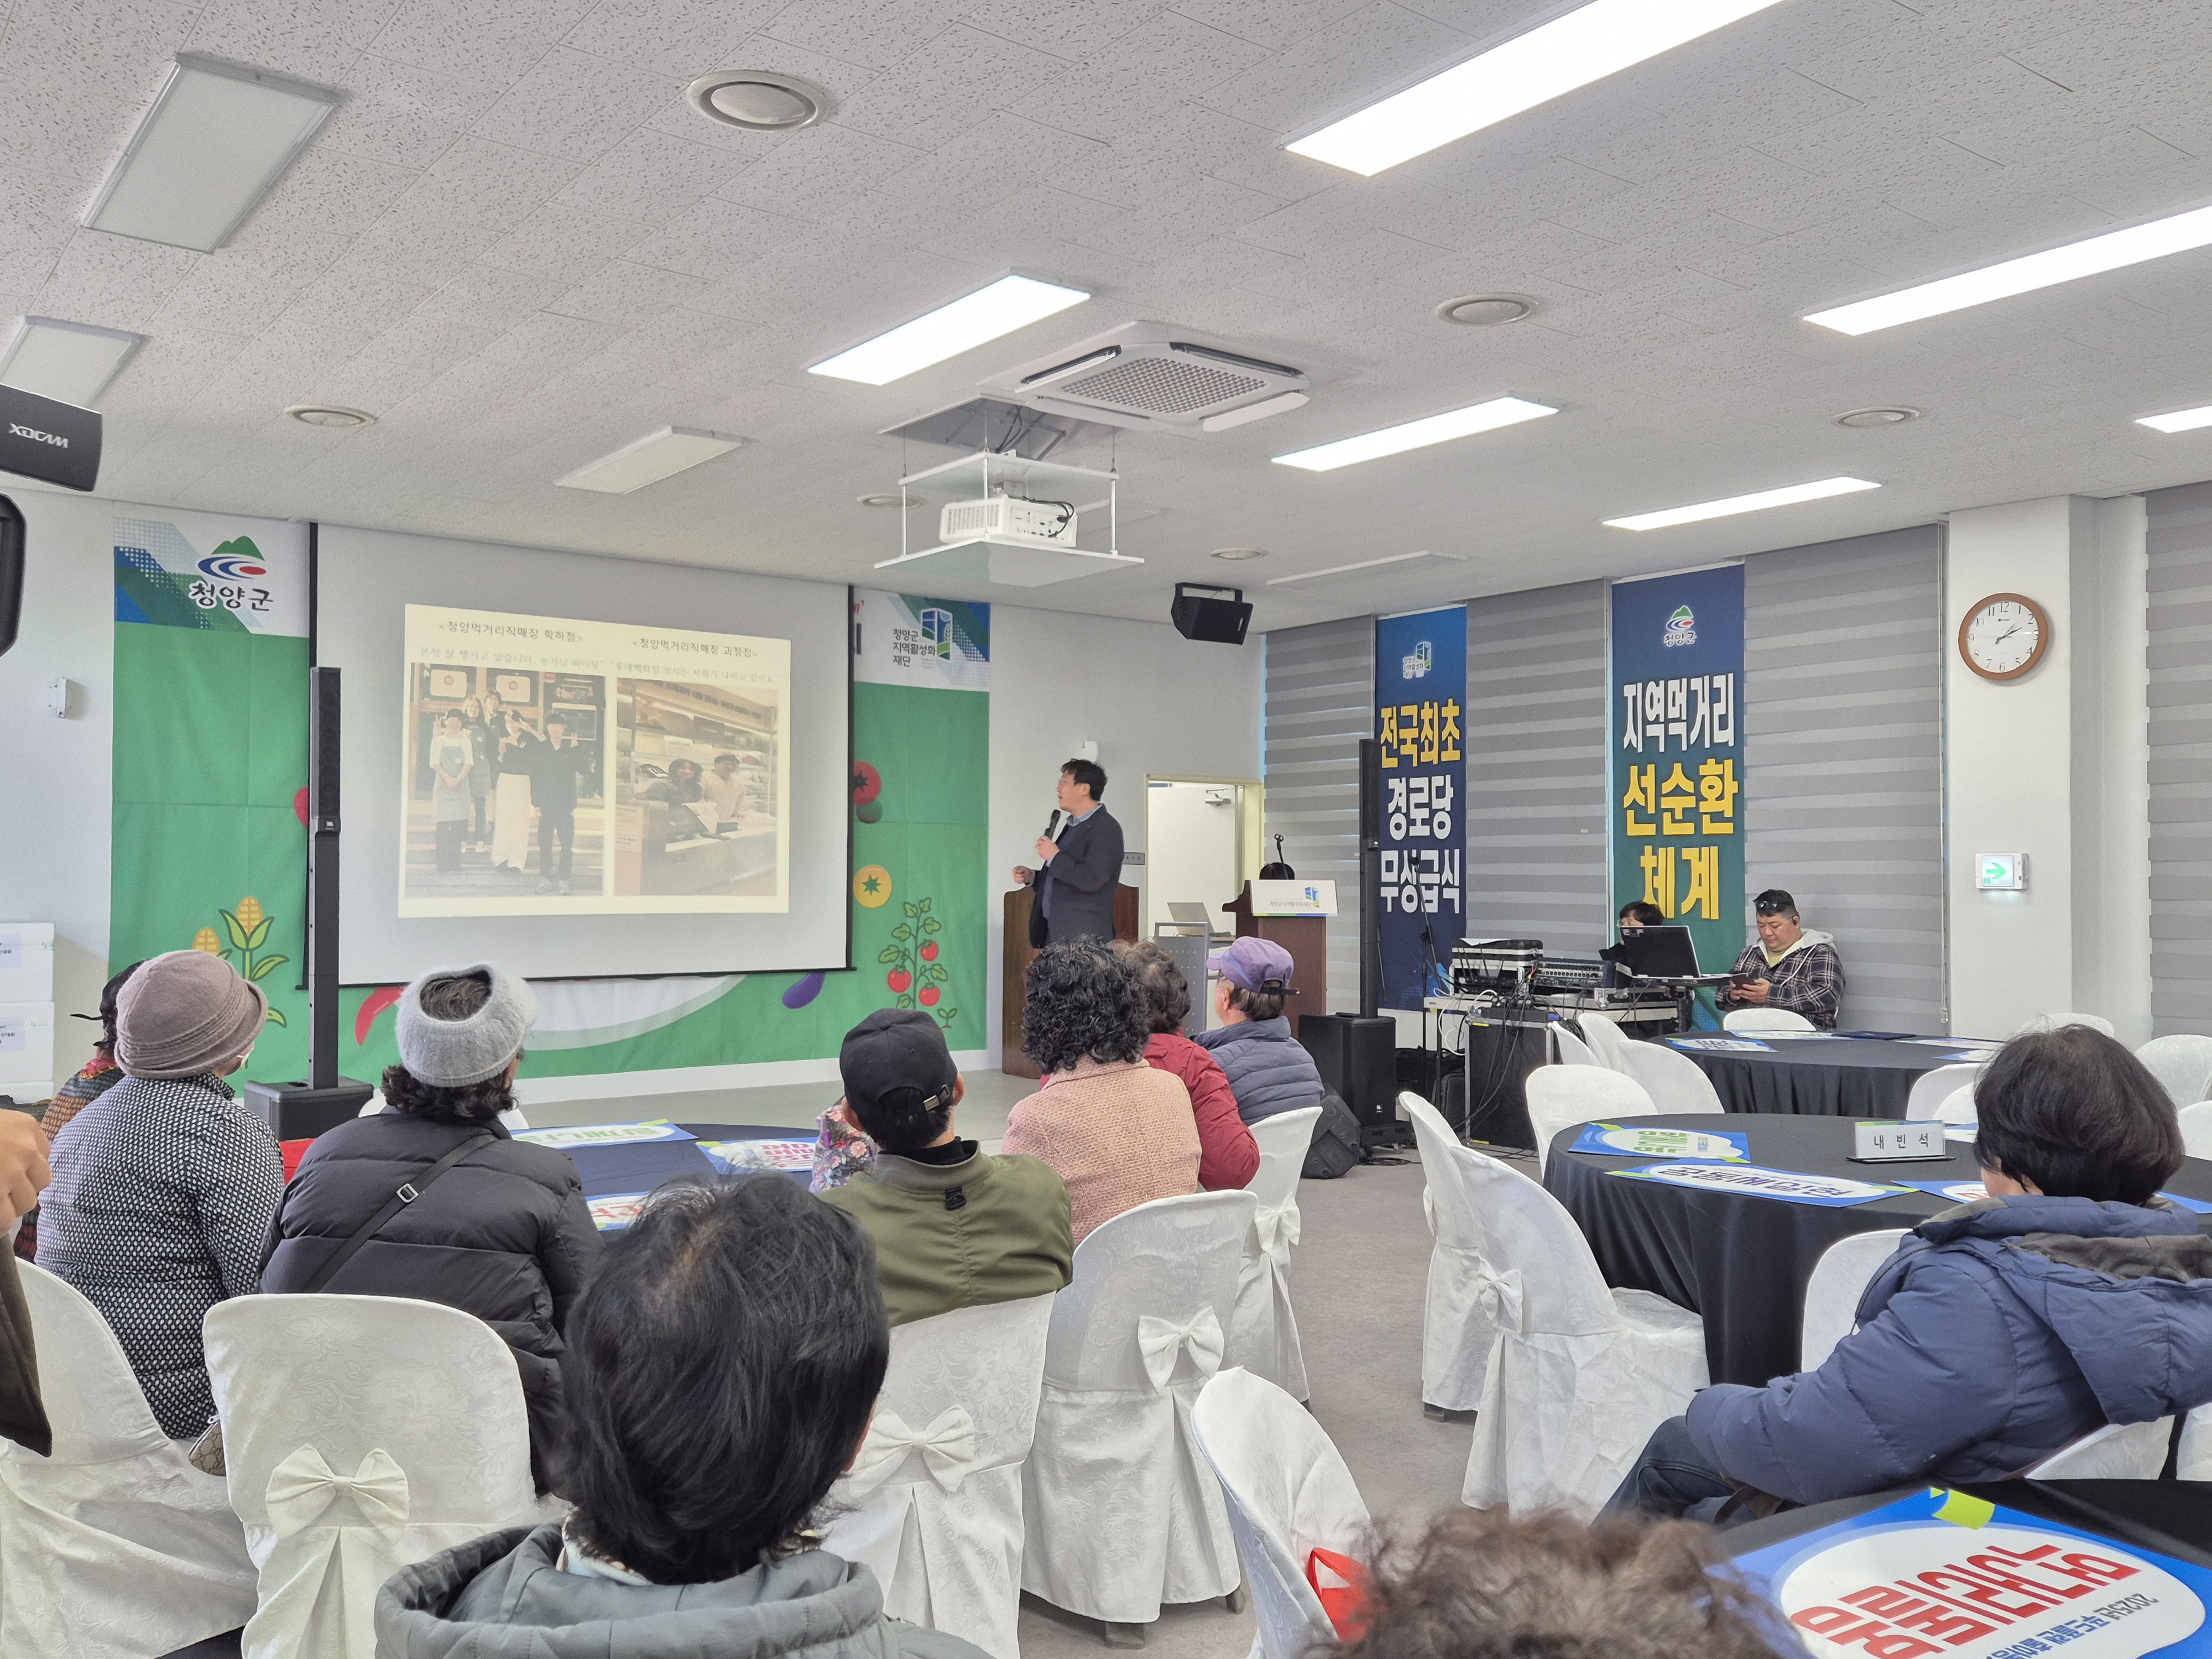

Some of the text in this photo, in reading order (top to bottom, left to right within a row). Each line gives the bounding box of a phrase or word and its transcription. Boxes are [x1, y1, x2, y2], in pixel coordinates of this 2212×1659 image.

[191, 583, 274, 611] 청양군
[1988, 606, 1995, 616] 11
[2000, 602, 2010, 612] 12
[2018, 605, 2021, 615] 1
[1976, 618, 1985, 627] 10
[2028, 614, 2034, 624] 2
[893, 628, 919, 642] 청양군
[1664, 632, 1697, 646] 청양군
[1968, 634, 1975, 643] 9
[2033, 630, 2039, 640] 3
[893, 642, 936, 656] 지역활성화
[1974, 649, 1980, 659] 8
[2026, 646, 2032, 657] 4
[893, 655, 911, 667] 재단
[1986, 659, 1992, 669] 7
[1999, 662, 2006, 672] 6
[2015, 658, 2021, 669] 5
[1623, 673, 1734, 753] 지역먹거리
[1380, 698, 1460, 768] 전국최초
[1623, 758, 1739, 836] 선순환
[1388, 774, 1454, 841] 경로당
[1380, 848, 1460, 914] 무상급식
[1640, 846, 1719, 920] 체계
[2093, 1593, 2159, 1620] 2025년
[2036, 1615, 2111, 1645] 푸드플랜
